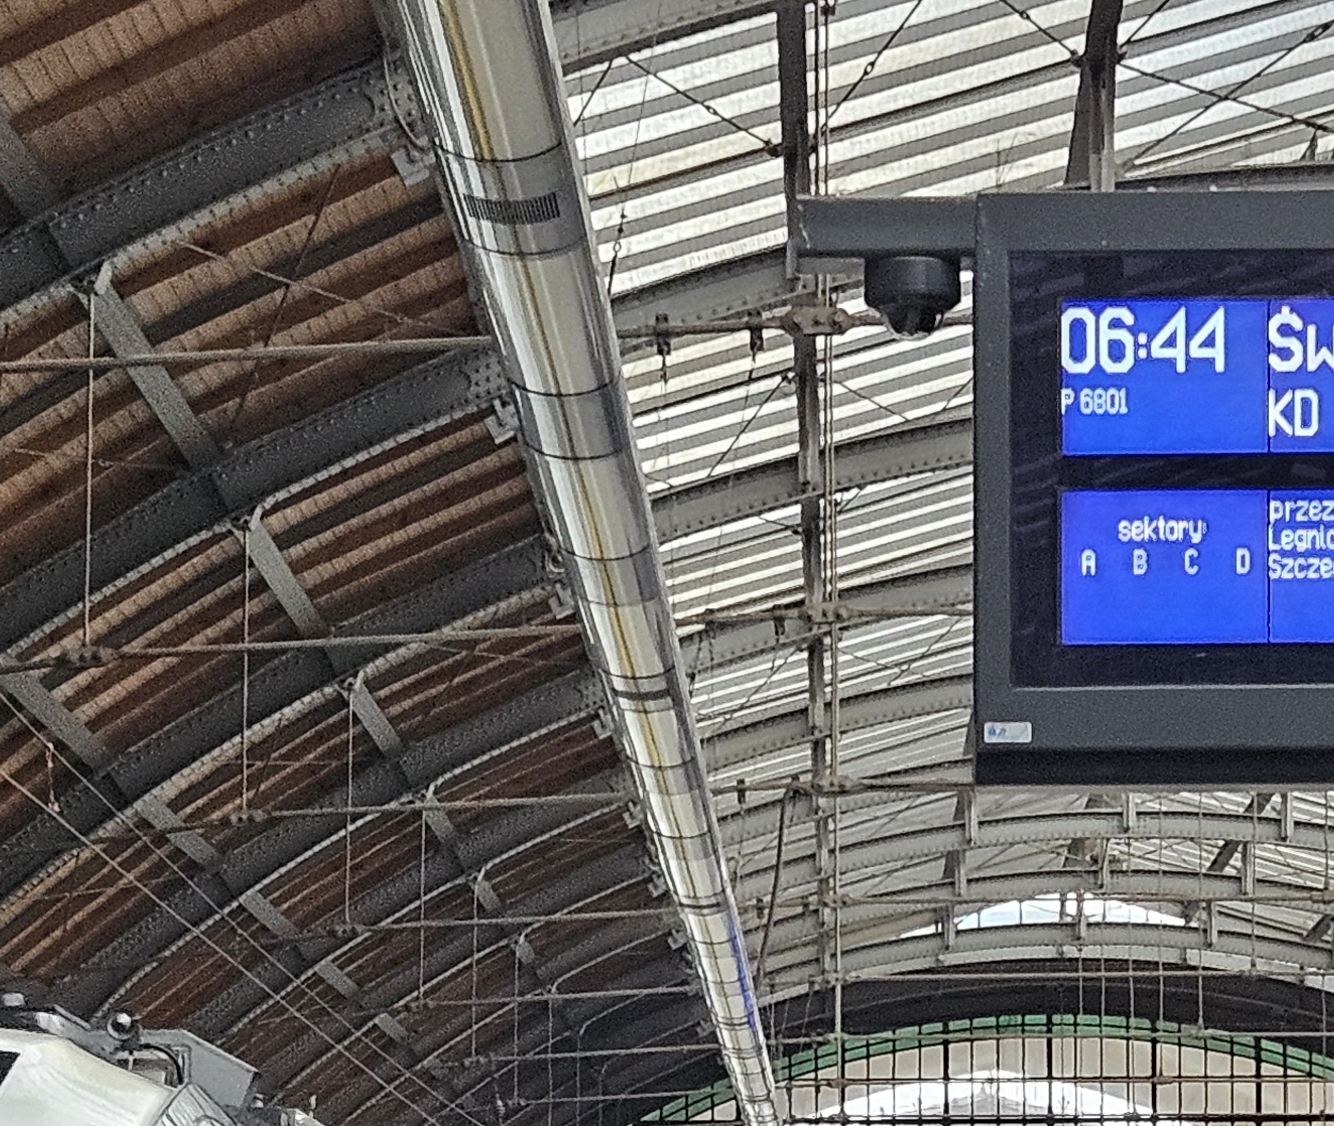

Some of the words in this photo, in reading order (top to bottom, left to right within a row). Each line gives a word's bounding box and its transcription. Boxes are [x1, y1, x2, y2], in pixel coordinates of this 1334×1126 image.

[1061, 306, 1226, 374] 06:44
[1061, 388, 1075, 415] P
[1080, 388, 1128, 414] 6801
[1269, 389, 1320, 437] KD
[1082, 549, 1096, 576] A
[1133, 548, 1147, 574] B
[1185, 548, 1199, 574] C
[1235, 548, 1250, 574] D
